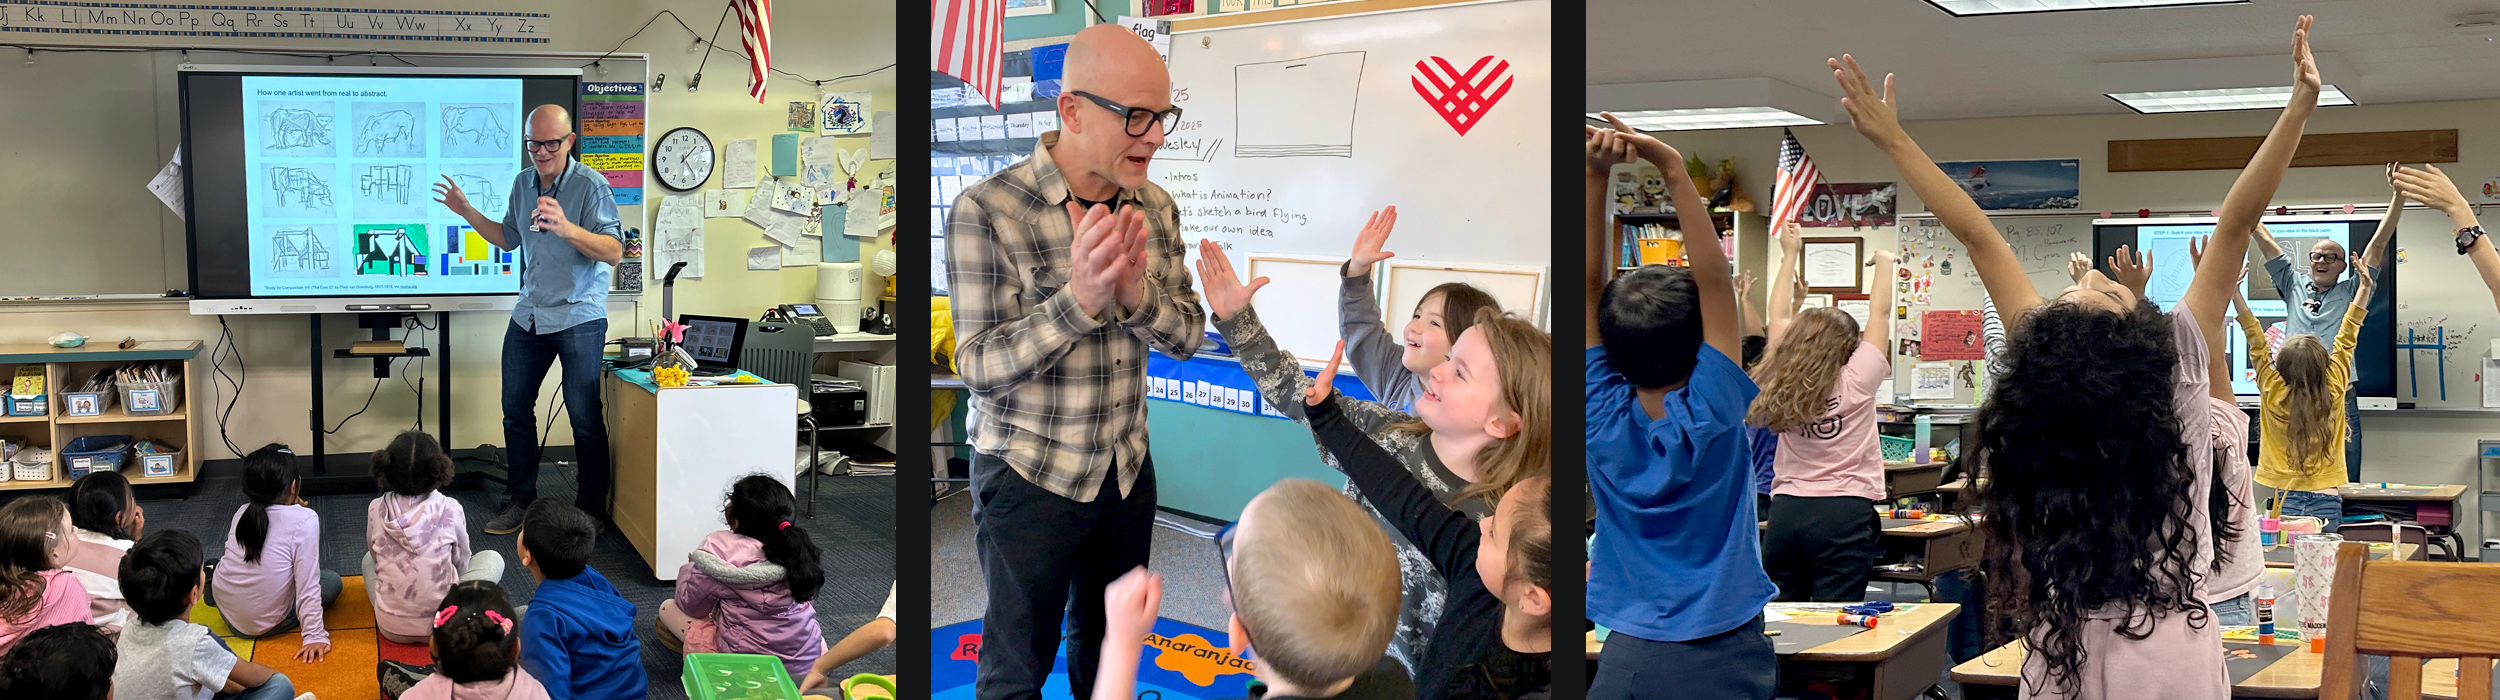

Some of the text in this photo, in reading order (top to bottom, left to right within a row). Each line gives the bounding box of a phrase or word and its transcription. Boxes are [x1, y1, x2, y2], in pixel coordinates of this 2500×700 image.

[25, 6, 45, 22] Kk
[61, 8, 78, 24] Ll
[88, 10, 118, 25] Mm
[123, 10, 146, 26] Nn
[151, 11, 174, 26] Oo
[179, 11, 200, 30] Pp
[212, 12, 237, 32] Qq
[246, 13, 263, 27] Rr
[273, 13, 288, 28] Ss
[300, 14, 315, 28] Tt
[336, 14, 354, 29] Uu
[368, 16, 384, 30] Vv
[396, 16, 426, 30] Ww
[455, 18, 472, 32] Xx
[487, 18, 502, 36] Yy
[517, 19, 535, 34] Zz
[1132, 23, 1155, 42] flag
[588, 84, 637, 94] Objectives
[1170, 172, 1198, 182] Intros
[1200, 190, 1207, 200] is
[1210, 188, 1272, 201] Animation?
[1180, 206, 1193, 216] et's
[1198, 206, 1232, 216] sketch
[1246, 206, 1267, 217] bird
[1802, 194, 1862, 222] LOVE
[1249, 225, 1274, 238] idea
